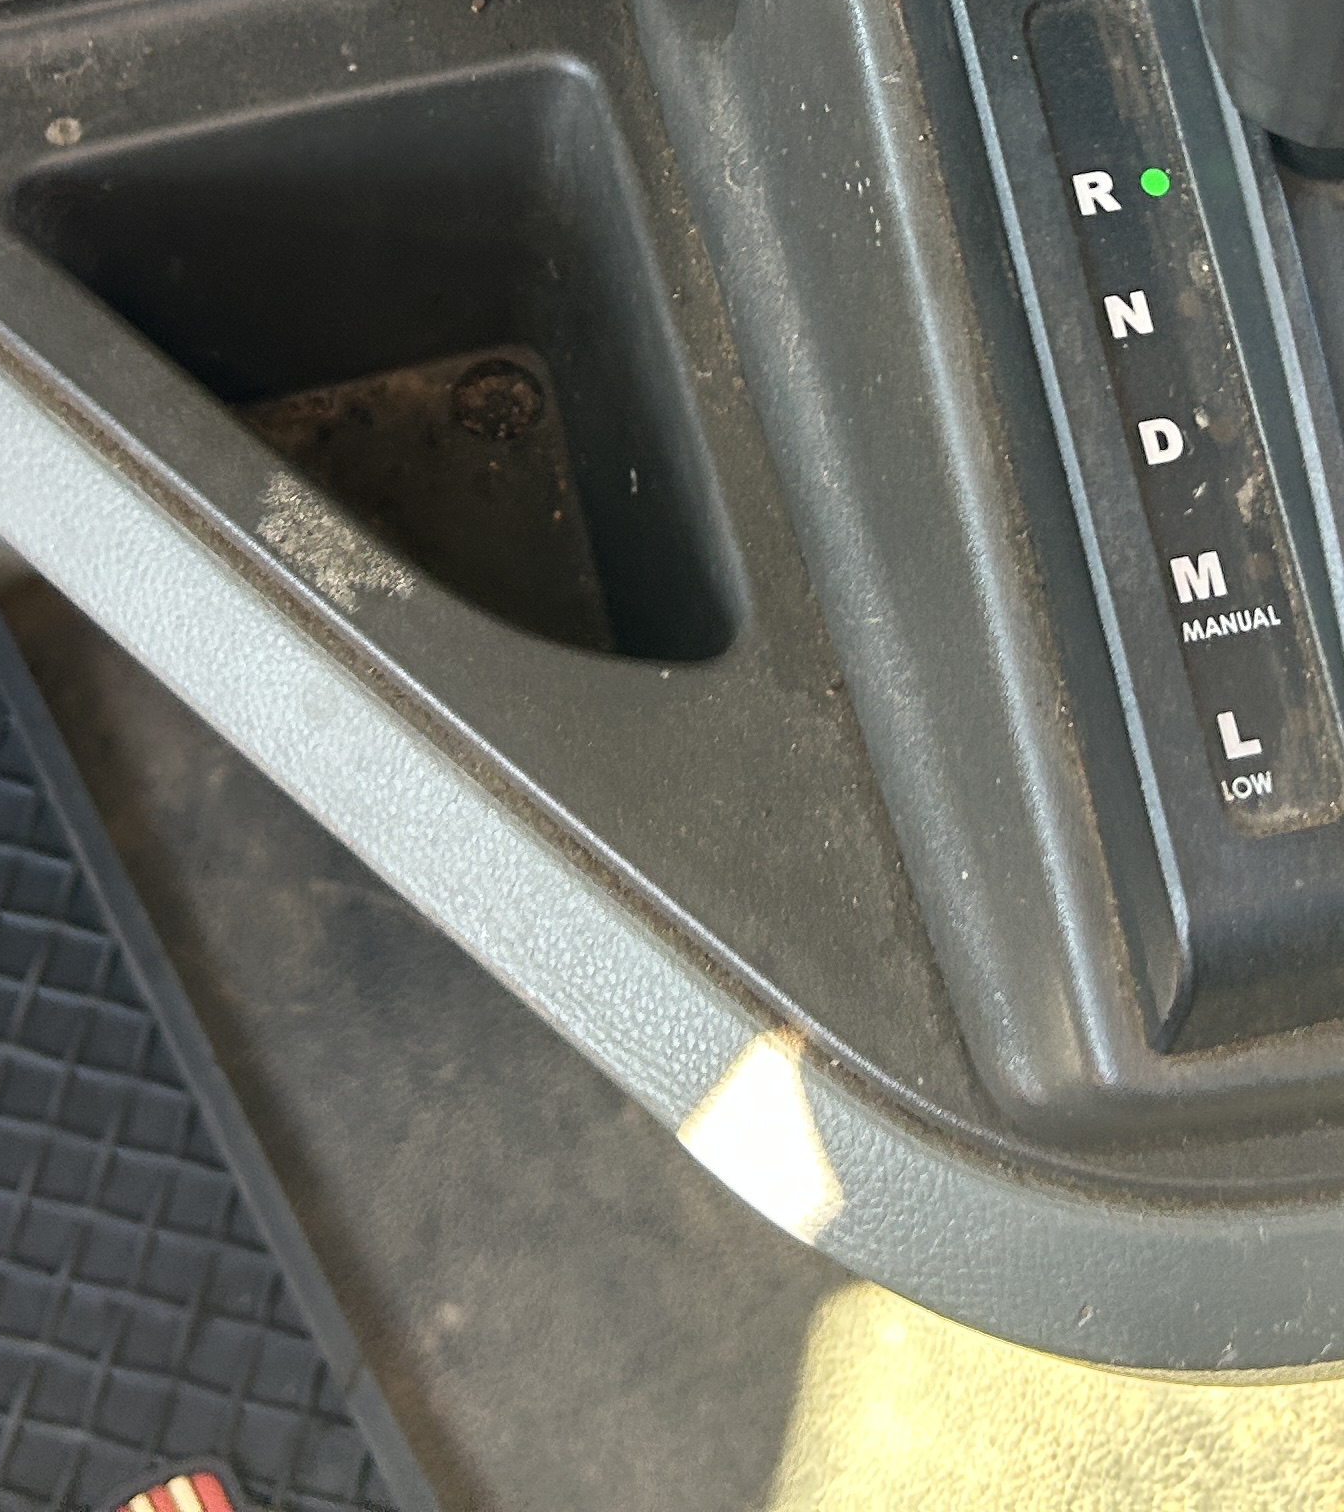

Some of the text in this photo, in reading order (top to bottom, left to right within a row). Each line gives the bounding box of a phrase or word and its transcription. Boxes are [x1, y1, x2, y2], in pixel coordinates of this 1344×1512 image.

[1072, 170, 1122, 216] R
[1104, 291, 1154, 338] N
[1138, 418, 1184, 465] D
[1170, 551, 1228, 603] M
[1183, 605, 1281, 643] MANUAL
[1216, 711, 1261, 760] L
[1221, 772, 1272, 802] LOW
